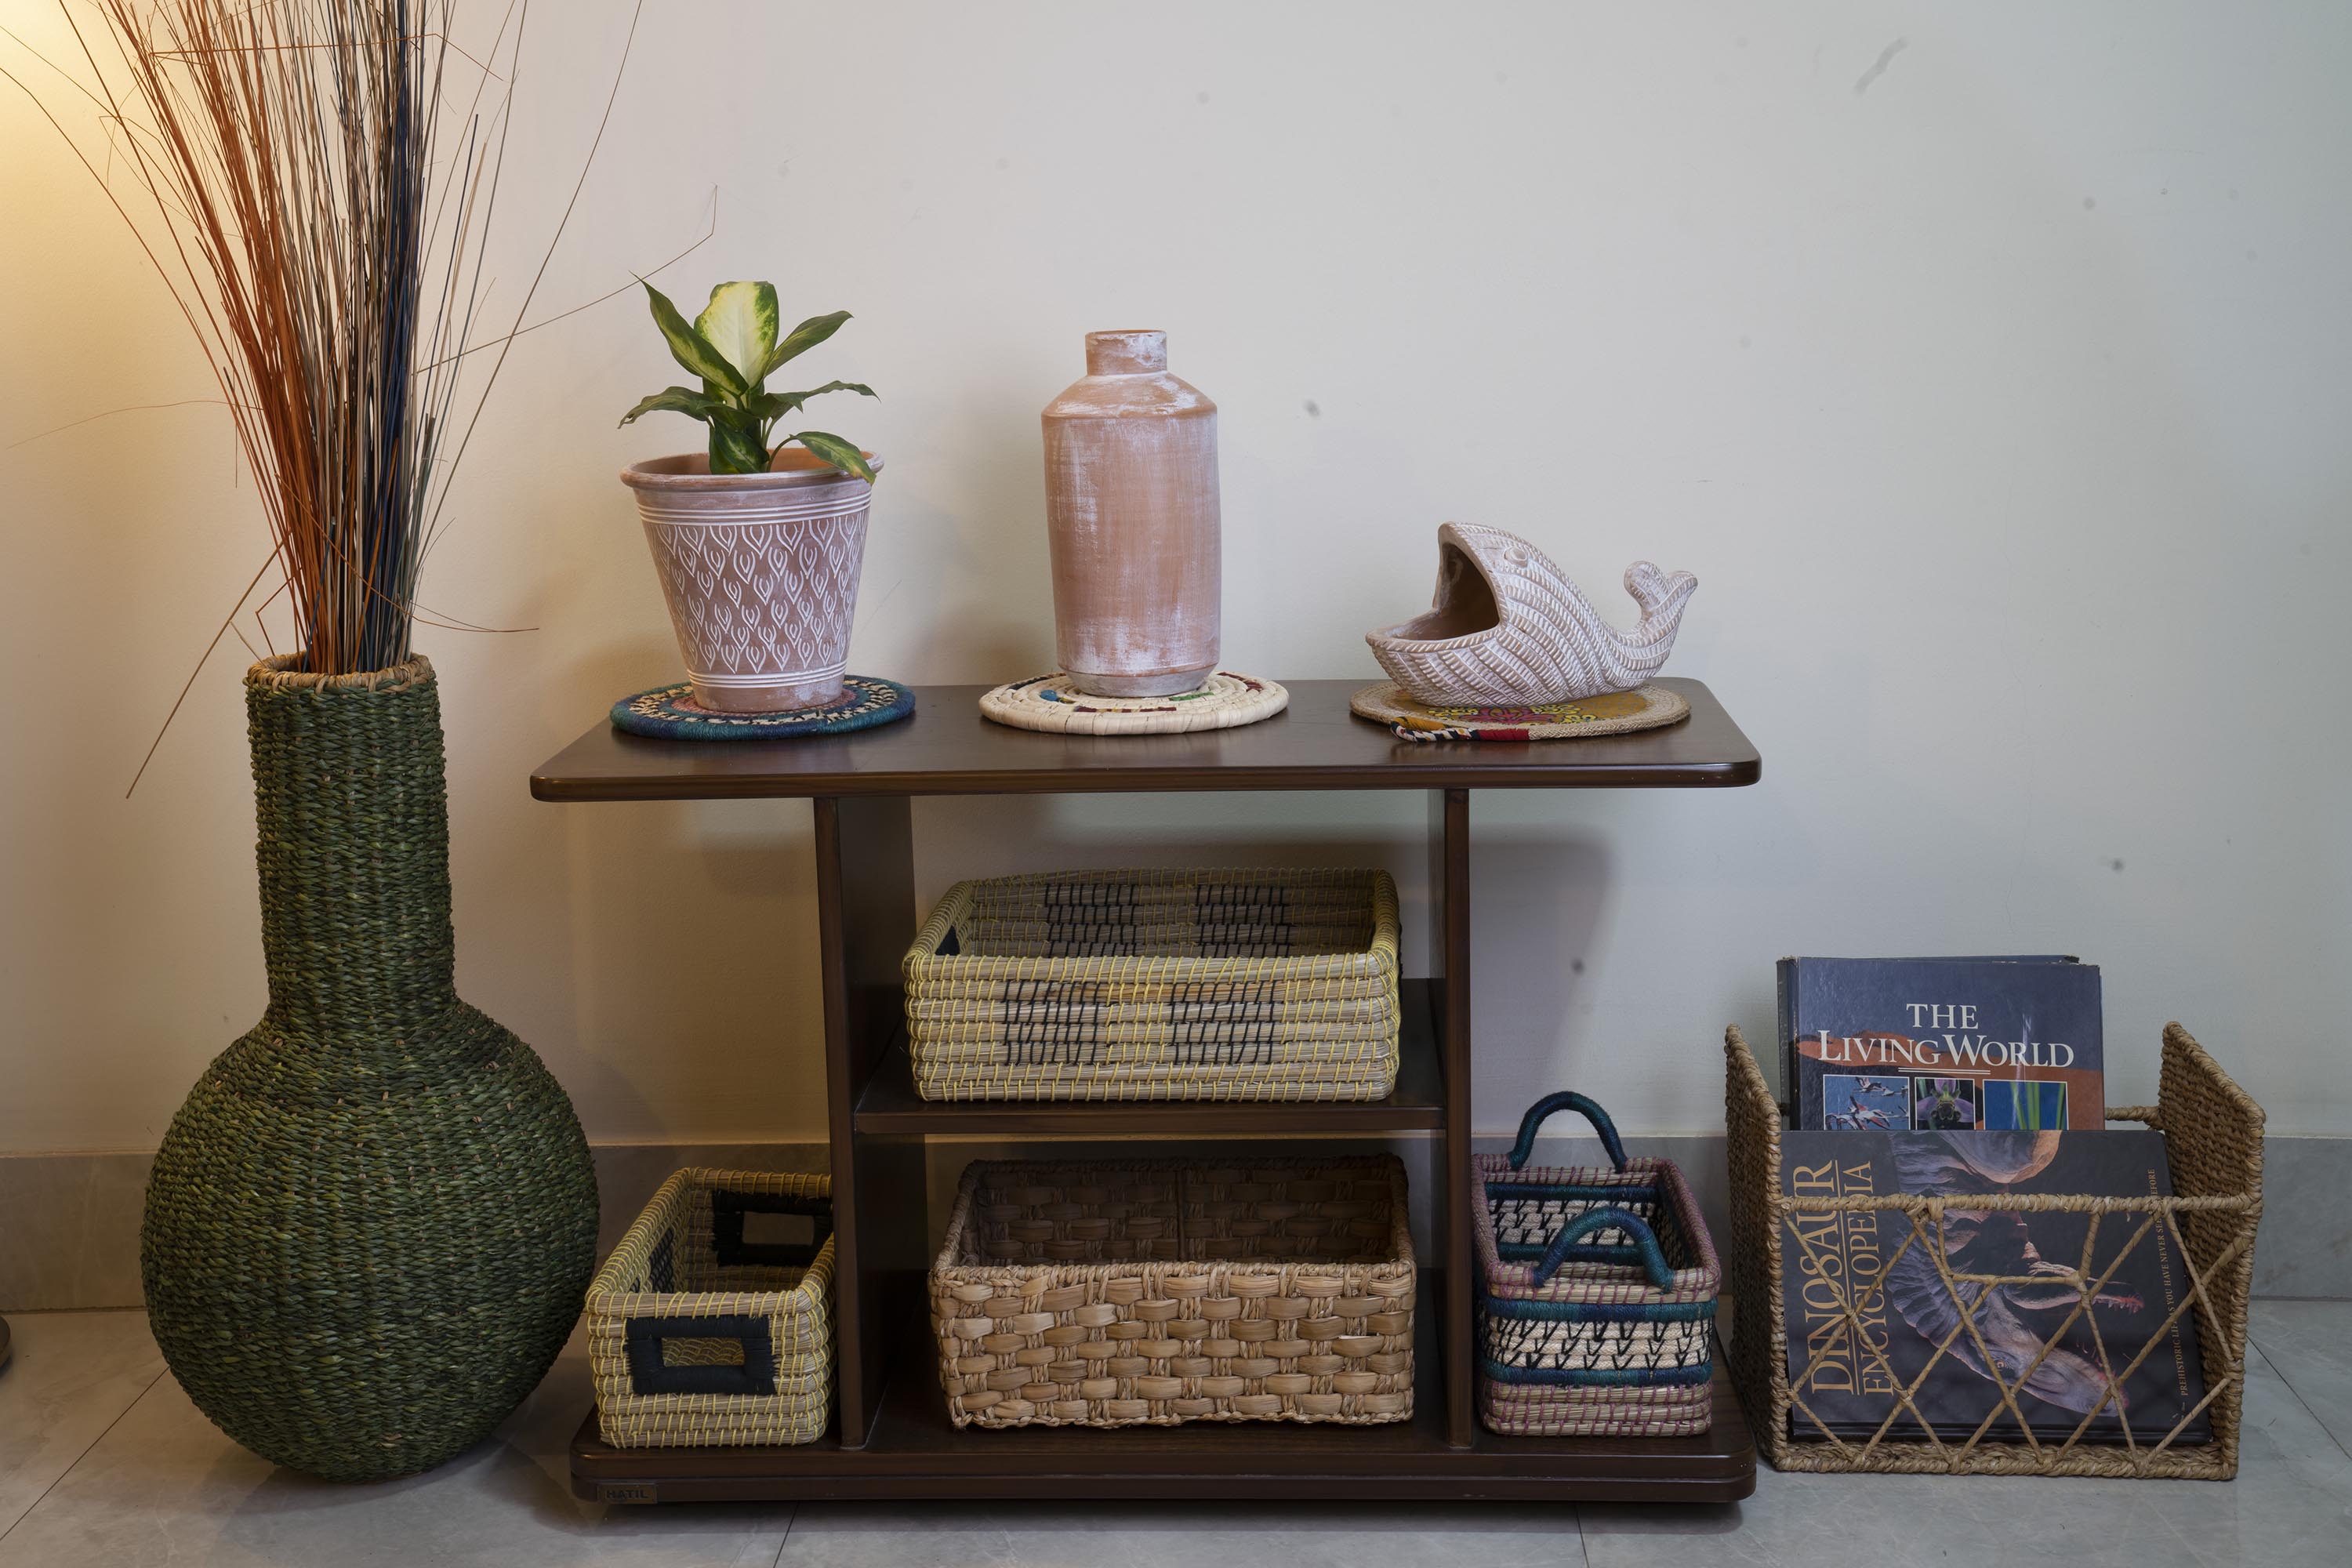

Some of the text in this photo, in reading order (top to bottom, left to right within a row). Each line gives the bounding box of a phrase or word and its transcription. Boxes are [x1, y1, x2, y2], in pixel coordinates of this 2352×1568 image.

[1906, 1003, 1979, 1029] THE
[1817, 1029, 2074, 1068] LIVING WORLD
[2147, 1169, 2158, 1195] EFORE
[2157, 1235, 2169, 1262] NEVER
[1793, 1160, 1854, 1396] DINOSAUR
[2161, 1264, 2172, 1286] HAVE
[2165, 1288, 2175, 1305] YOU
[2172, 1338, 2188, 1396] PREHISTORIC
[607, 1490, 648, 1498] HATIL
